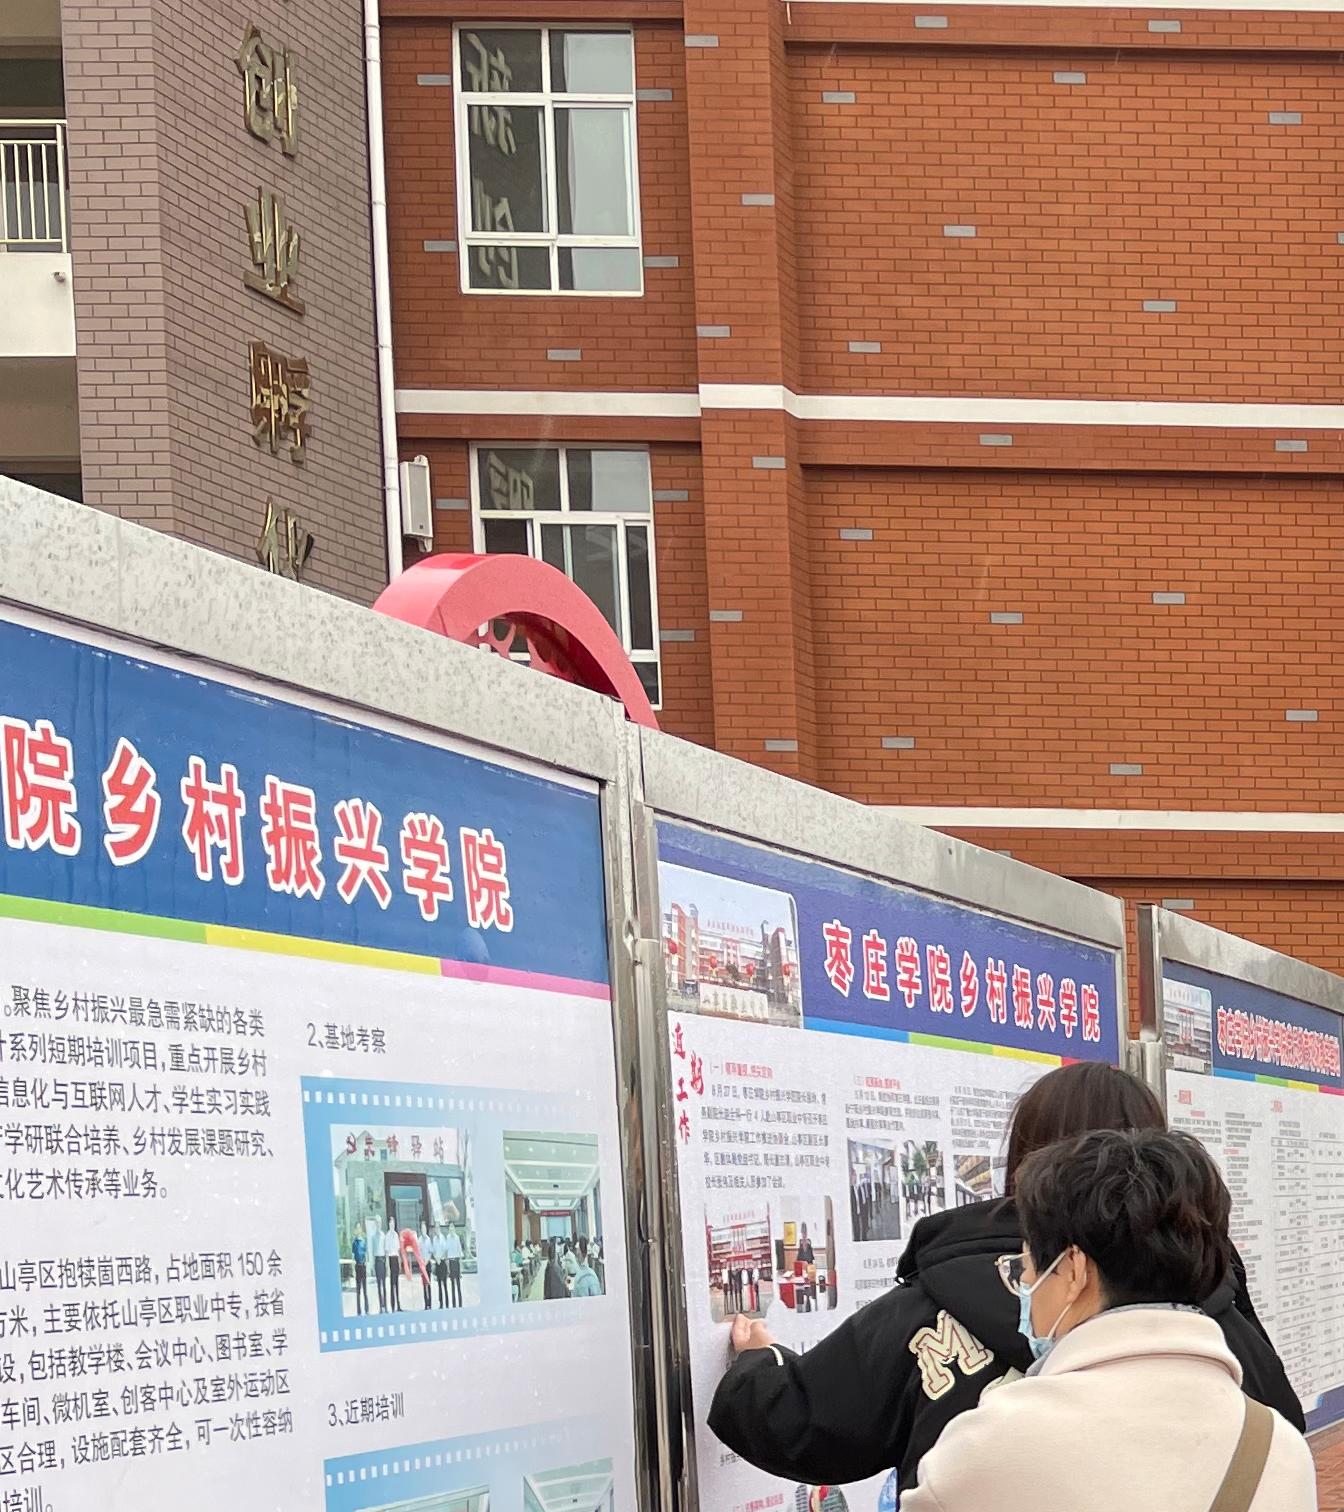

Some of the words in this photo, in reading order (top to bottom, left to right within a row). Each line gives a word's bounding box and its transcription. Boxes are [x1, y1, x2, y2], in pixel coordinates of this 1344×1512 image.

[0, 716, 513, 932] 院乡村振兴学院
[823, 919, 1101, 1042] 枣庄学院乡村振兴学院
[307, 1022, 386, 1054] 2、基地考察
[0, 1122, 274, 1157] 学研联合培养、乡村发展课题研究、
[0, 1167, 167, 1200] 化艺术传承等业务。
[908, 1309, 995, 1400] M
[328, 1391, 404, 1426] 3、近期培训
